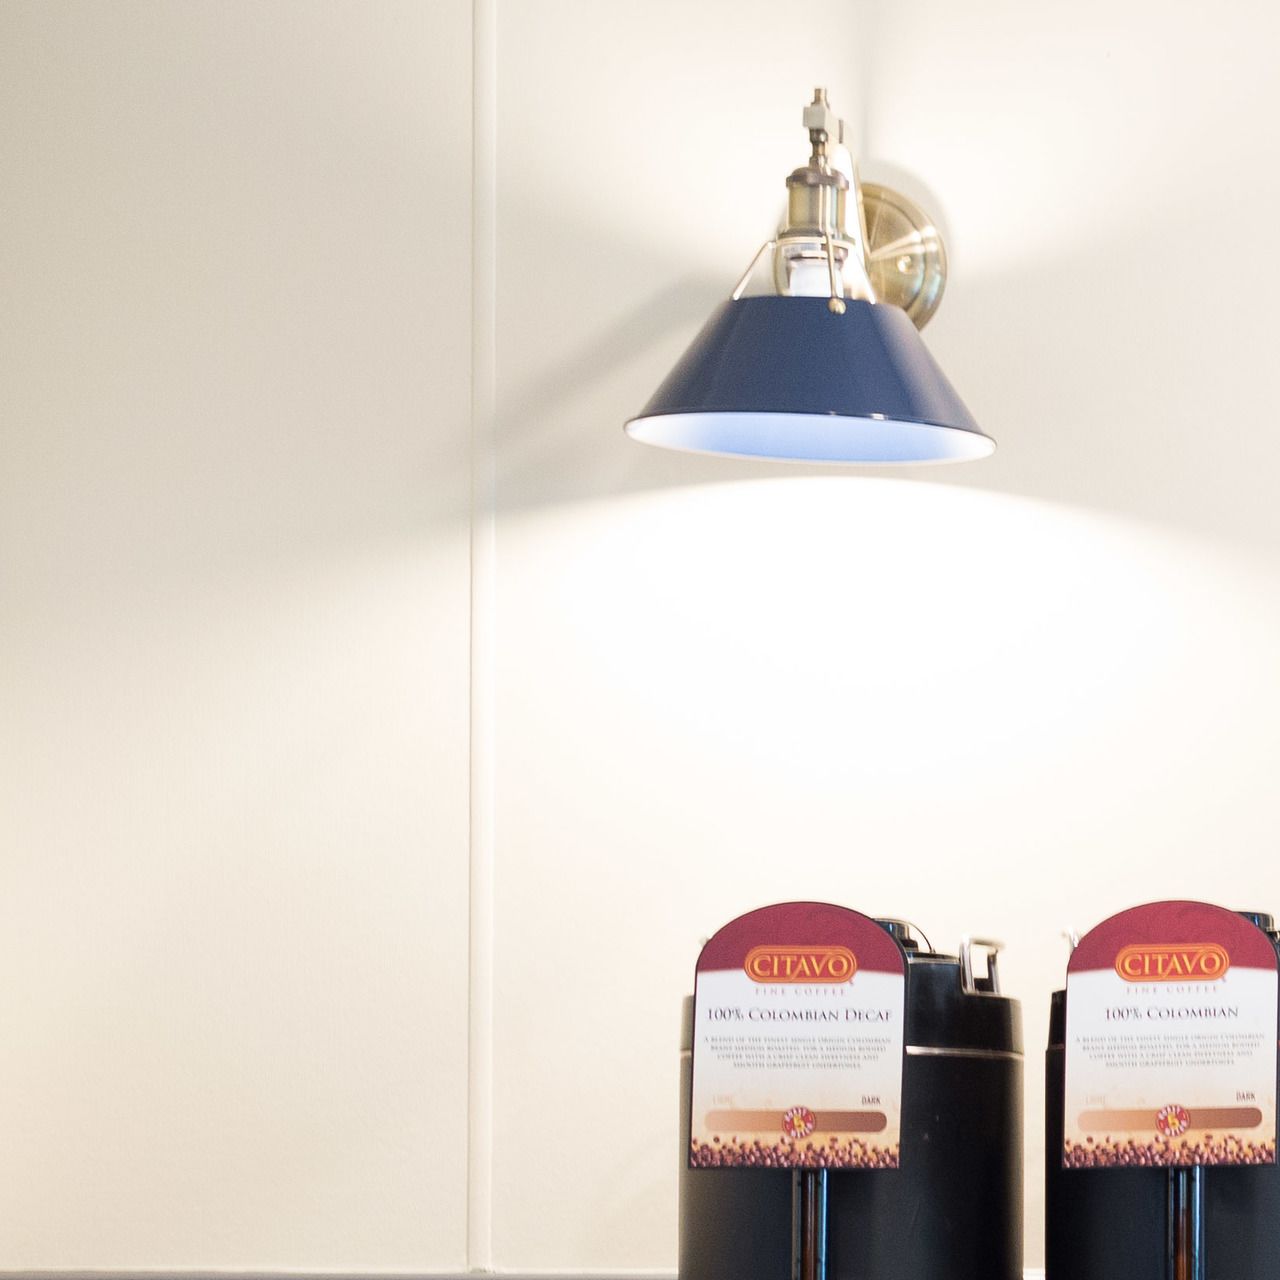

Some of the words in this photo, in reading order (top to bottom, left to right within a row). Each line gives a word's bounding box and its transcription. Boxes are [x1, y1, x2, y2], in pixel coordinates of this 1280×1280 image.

[752, 954, 850, 978] CITAVO
[1123, 952, 1222, 977] CITAVO
[707, 1007, 744, 1022] 100%
[748, 1007, 839, 1022] COLOMBIAN
[845, 1007, 893, 1022] DECAF
[1106, 1007, 1143, 1022] 100%
[1147, 1006, 1240, 1021] COLOMBIAN
[861, 1095, 882, 1105] DARK
[1236, 1091, 1257, 1102] DARK
